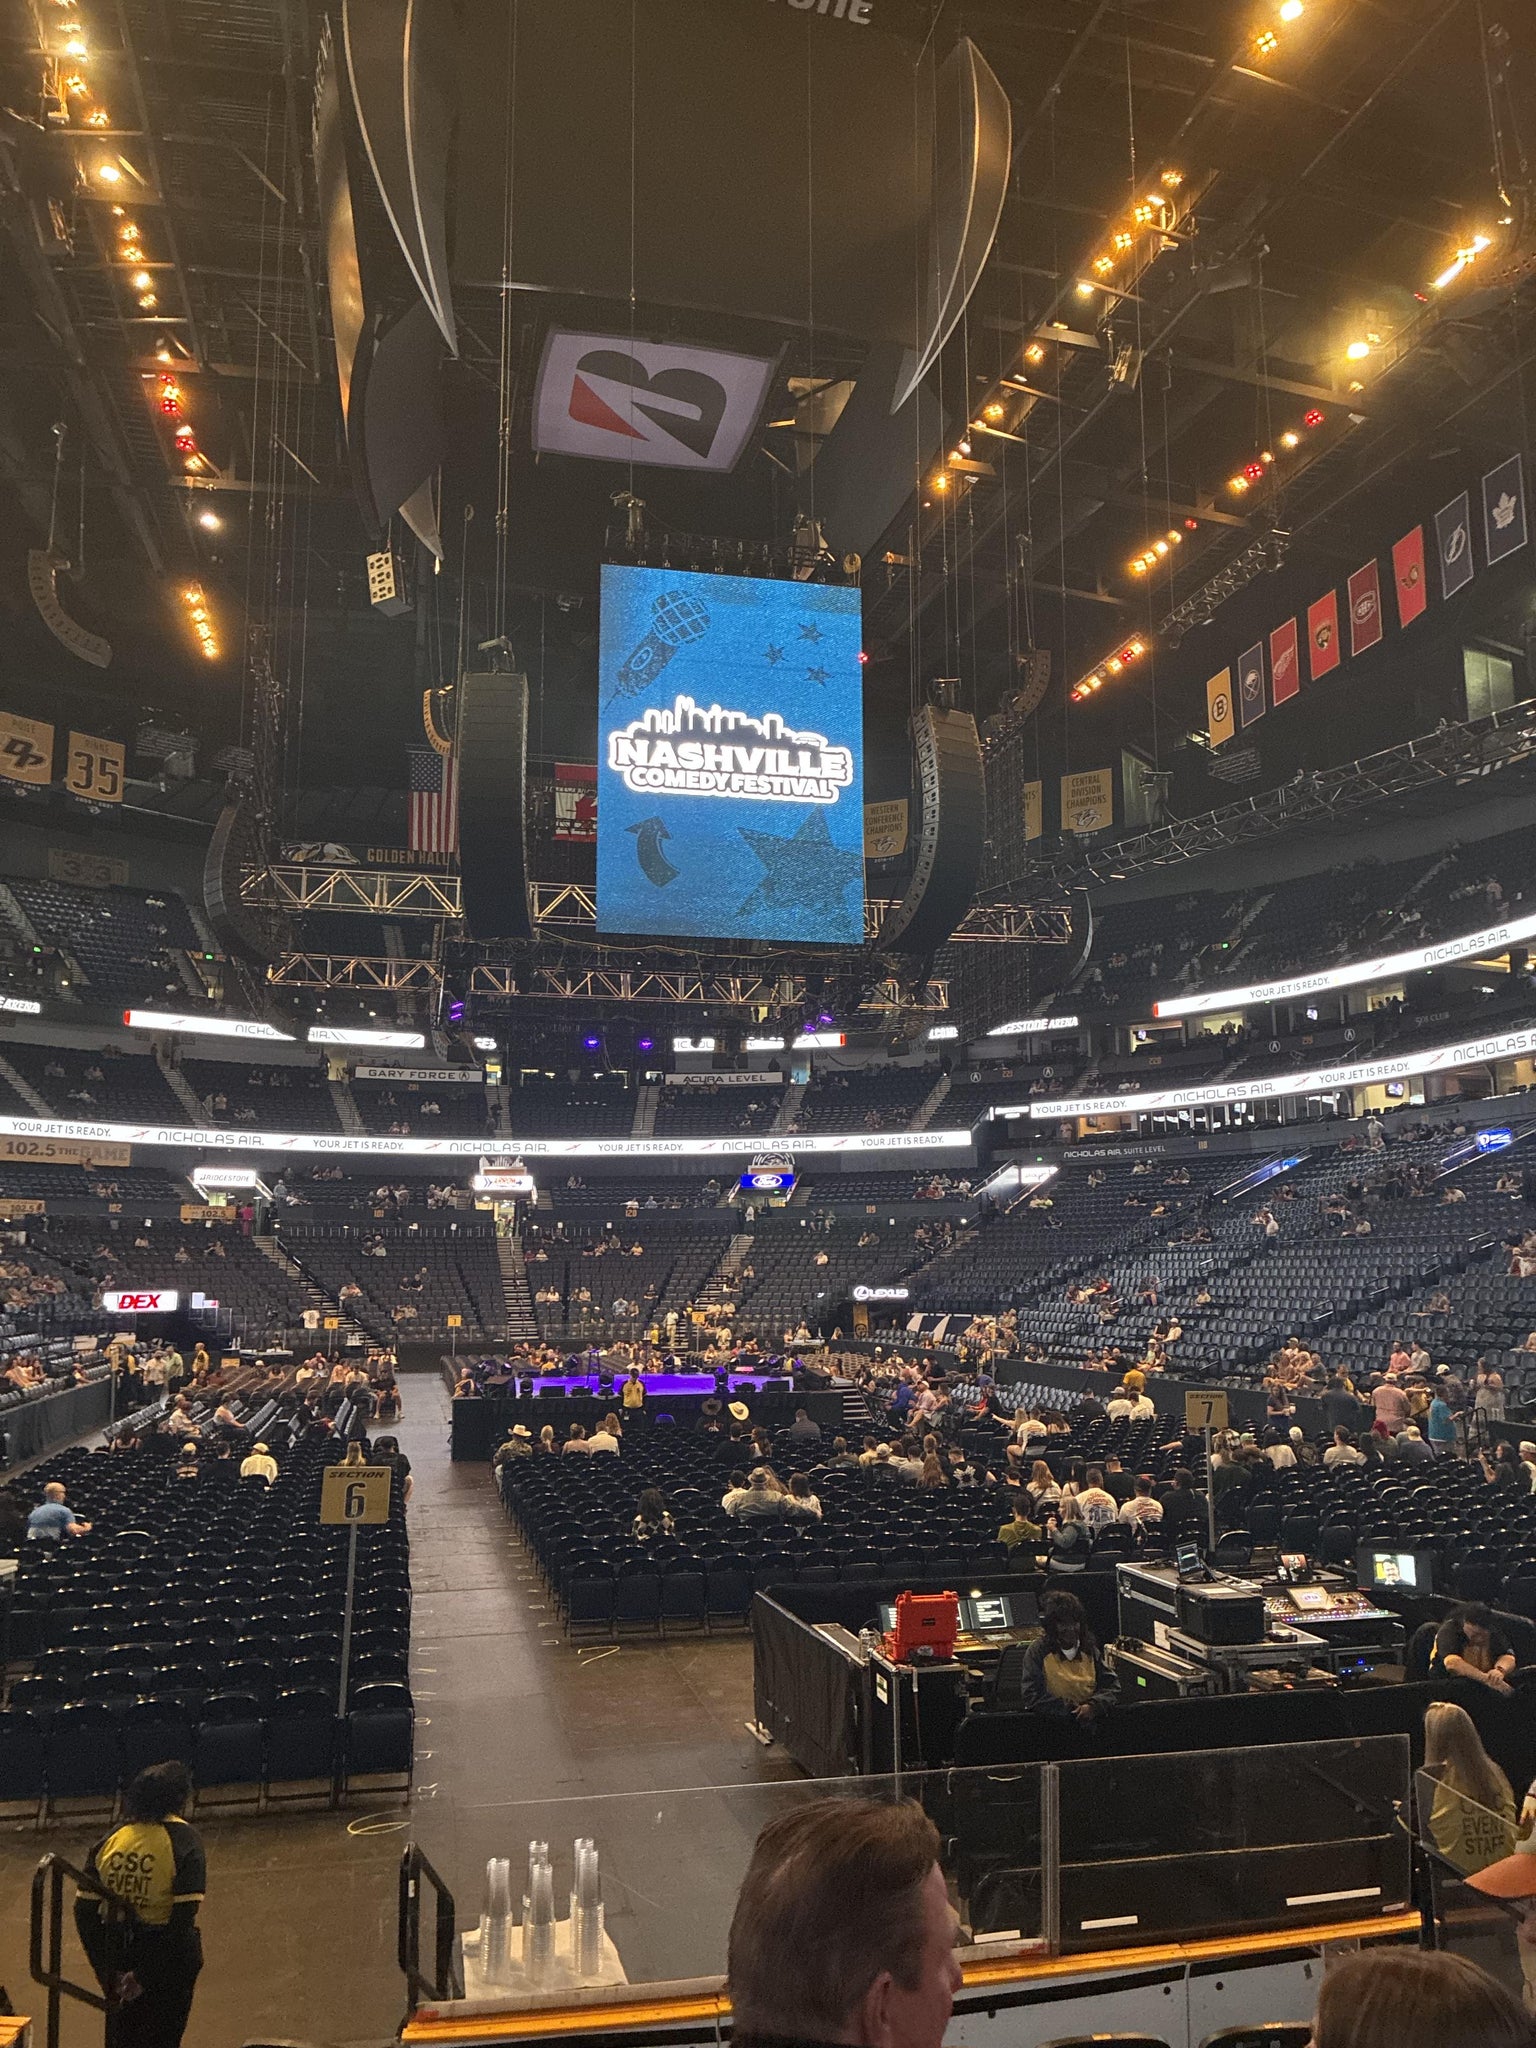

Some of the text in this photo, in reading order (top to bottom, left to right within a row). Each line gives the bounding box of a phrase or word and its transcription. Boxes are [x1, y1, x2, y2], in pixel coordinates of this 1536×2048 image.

[616, 737, 848, 779] NASHVILLE
[72, 751, 119, 796] 35
[631, 767, 833, 798] COMEDY FESTIVAL
[1071, 774, 1100, 788] CENTRAL
[1071, 785, 1102, 798] DIVISION
[870, 803, 899, 815] WESTERN
[1066, 794, 1107, 810] CHAMPIONS
[865, 812, 904, 826] CONFERENCE
[866, 822, 903, 836] CHAMPIONS
[367, 848, 415, 865] GOLDEN
[1424, 929, 1511, 963] NICHOLAS AIR.
[1250, 976, 1330, 999] YOUR JET IS READY.
[1453, 1035, 1527, 1062] NICHOLAS
[368, 1069, 456, 1080] GARY FORCE
[683, 1074, 767, 1084] ACURA LEVEL
[1319, 1062, 1411, 1084] YOUR JET IS READY.
[1173, 1082, 1276, 1104] NICHOLAS AIR.
[1035, 1100, 1127, 1114] YOUR JET IS READY.
[12, 1121, 945, 1153] YOUR JET IS READY. NICHOLAS AIR. YOUR JET IS READY. NICHOLAS AIR. YOUR JET IS READY. NICHOLAS AIR. YOUR JET IS READY.
[6, 1141, 129, 1161] 102.5 THE GAME
[1063, 1149, 1106, 1159] NICHOLAS
[1123, 1147, 1144, 1155] SUITE
[1144, 1144, 1166, 1154] LEVEL
[118, 1293, 162, 1310] DEX
[868, 1288, 909, 1298] LEXUS
[1201, 1401, 1213, 1424] 7
[329, 1471, 386, 1479] SECTION
[345, 1482, 367, 1519] 6
[1465, 1834, 1506, 1856] STAFF
[110, 1851, 156, 1873] CSC
[107, 1873, 152, 1896] EVENT
